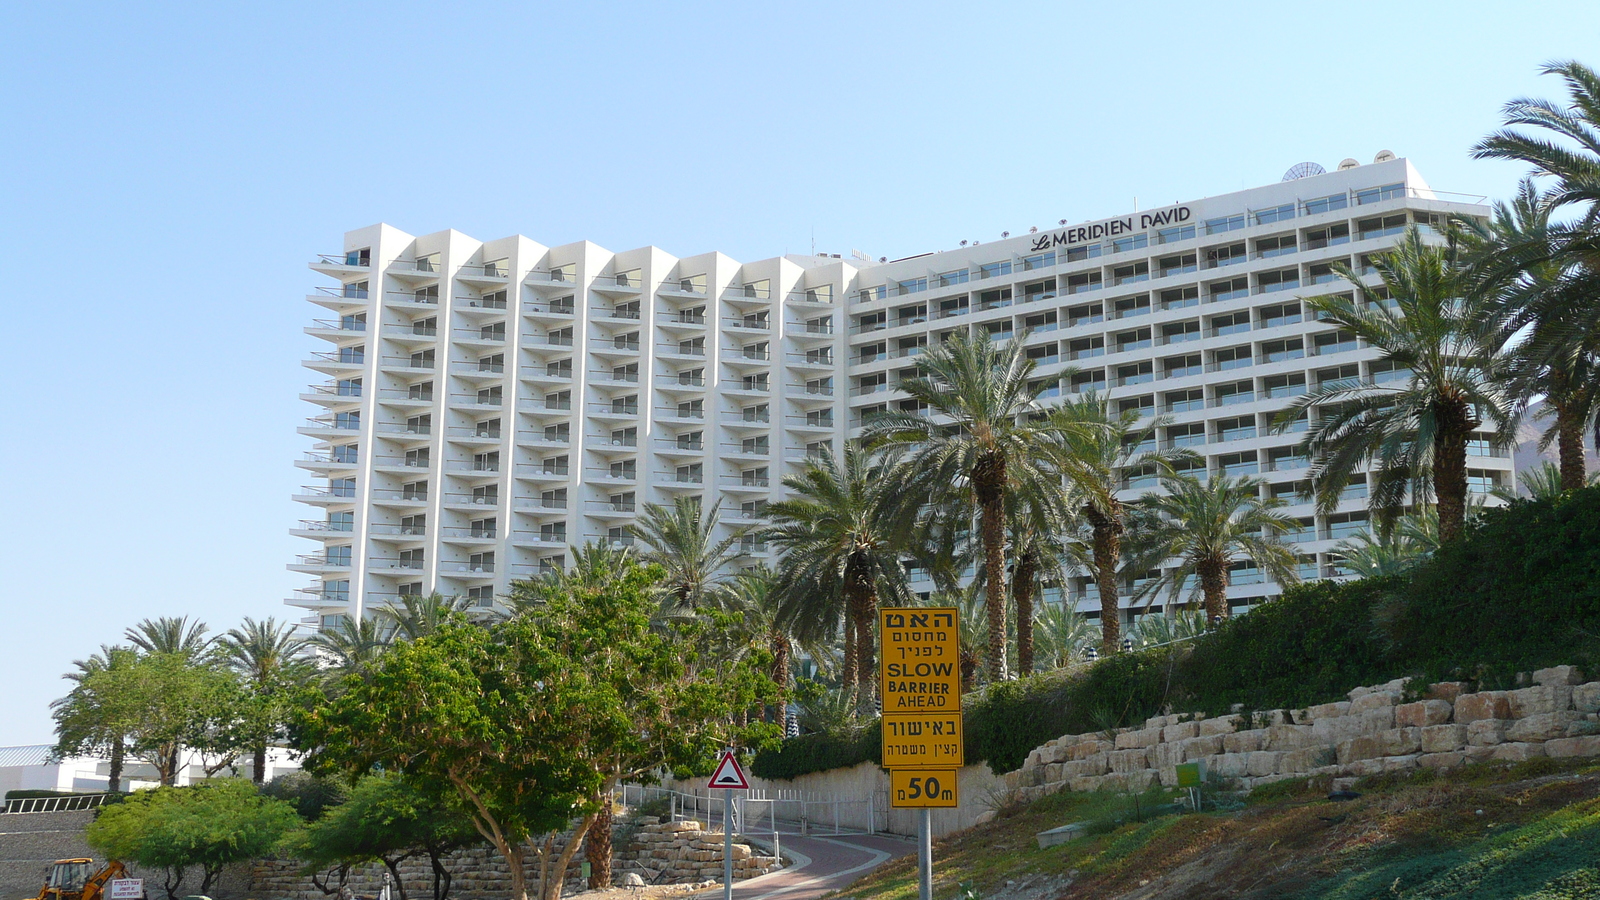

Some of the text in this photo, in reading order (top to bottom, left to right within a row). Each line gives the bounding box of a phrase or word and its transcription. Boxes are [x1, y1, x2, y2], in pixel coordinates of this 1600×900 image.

[1031, 207, 1190, 251] Le MERIDIEN DAVID
[885, 613, 953, 628] האט
[892, 632, 947, 642] מחסום
[897, 645, 943, 659] לפניך
[887, 663, 953, 677] SLOW
[888, 681, 949, 694] BARRIER
[897, 695, 946, 707] AHEAD
[888, 721, 956, 736] באישור
[887, 744, 958, 757] קצין משטרה
